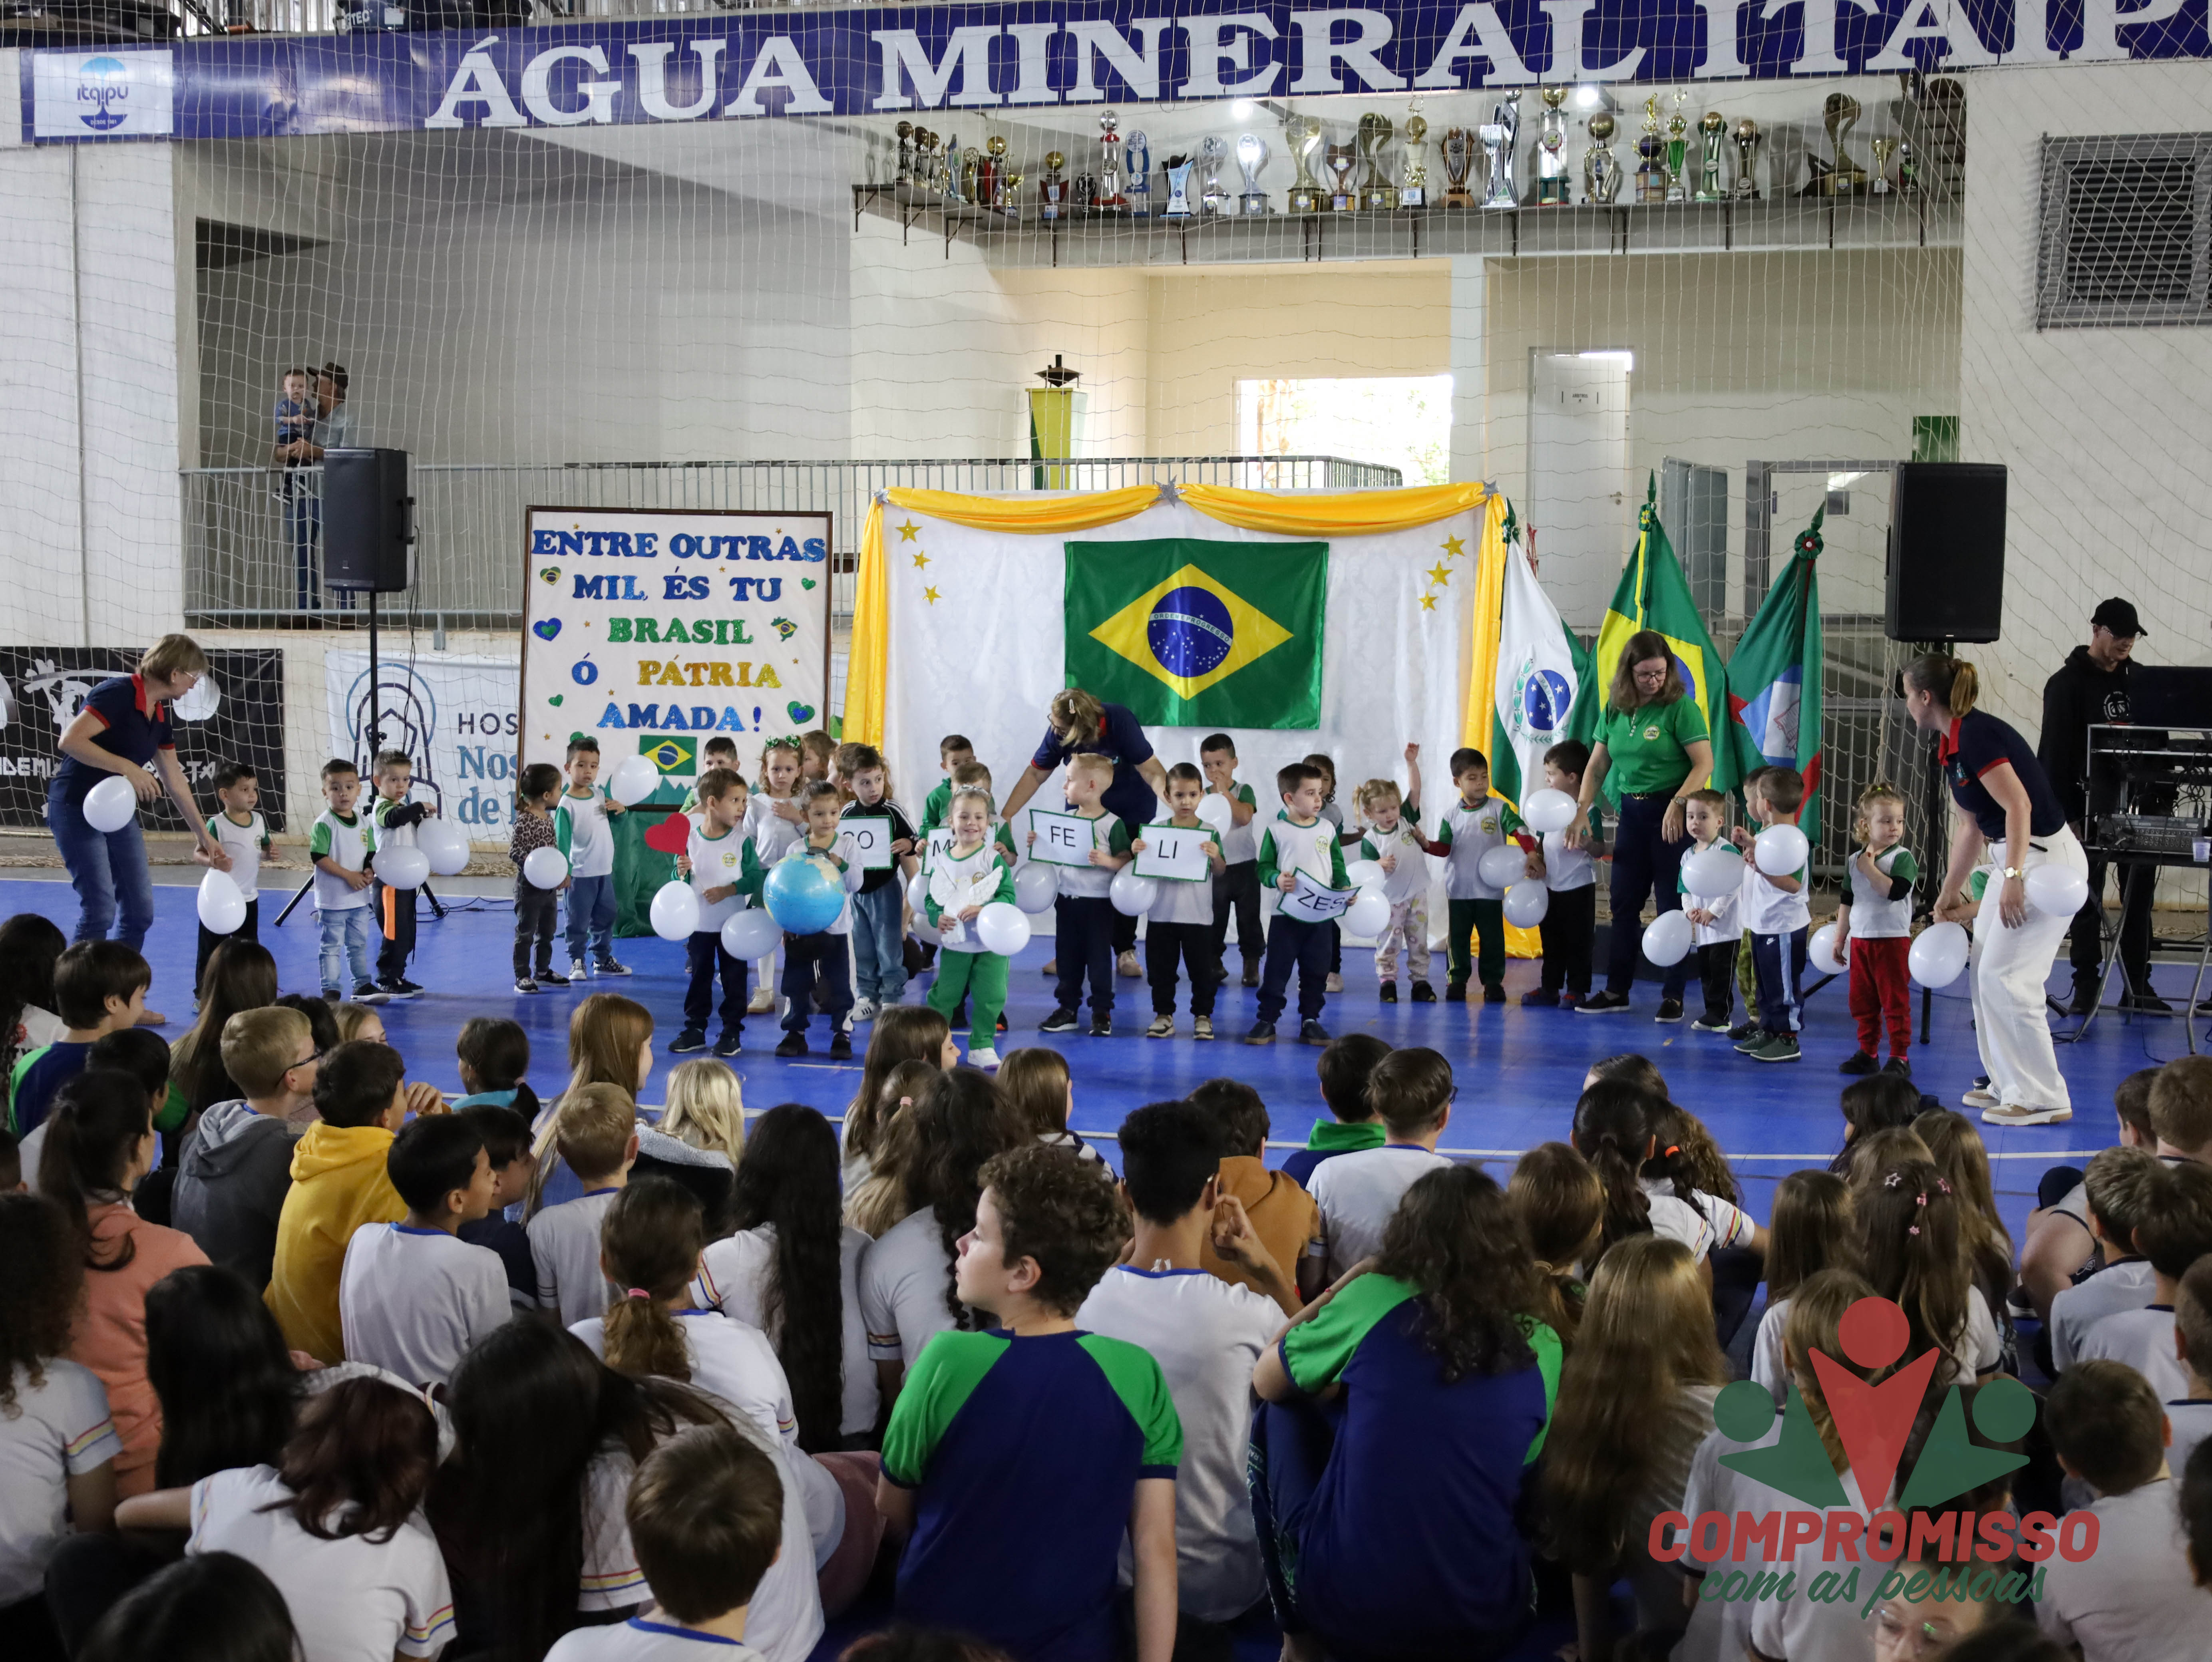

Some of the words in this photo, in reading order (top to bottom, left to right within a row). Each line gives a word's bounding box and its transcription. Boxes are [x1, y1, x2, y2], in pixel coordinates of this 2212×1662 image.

[424, 34, 833, 128] ÁGUA
[871, 0, 1647, 108] MINERAL
[1694, 0, 2212, 77] ITAIP
[531, 530, 658, 558] ENTRE
[669, 533, 826, 562] OUTRAS
[663, 566, 710, 600] ÉS
[730, 577, 782, 601] TU
[608, 617, 753, 644] BRASIL
[1187, 616, 1229, 642] PROGRESSO
[572, 652, 598, 685] Ó
[637, 654, 782, 688] PÁTRIA
[458, 786, 500, 824] de
[1050, 825, 1076, 847] FE
[1158, 839, 1178, 859] LI
[1297, 887, 1346, 911] ZES
